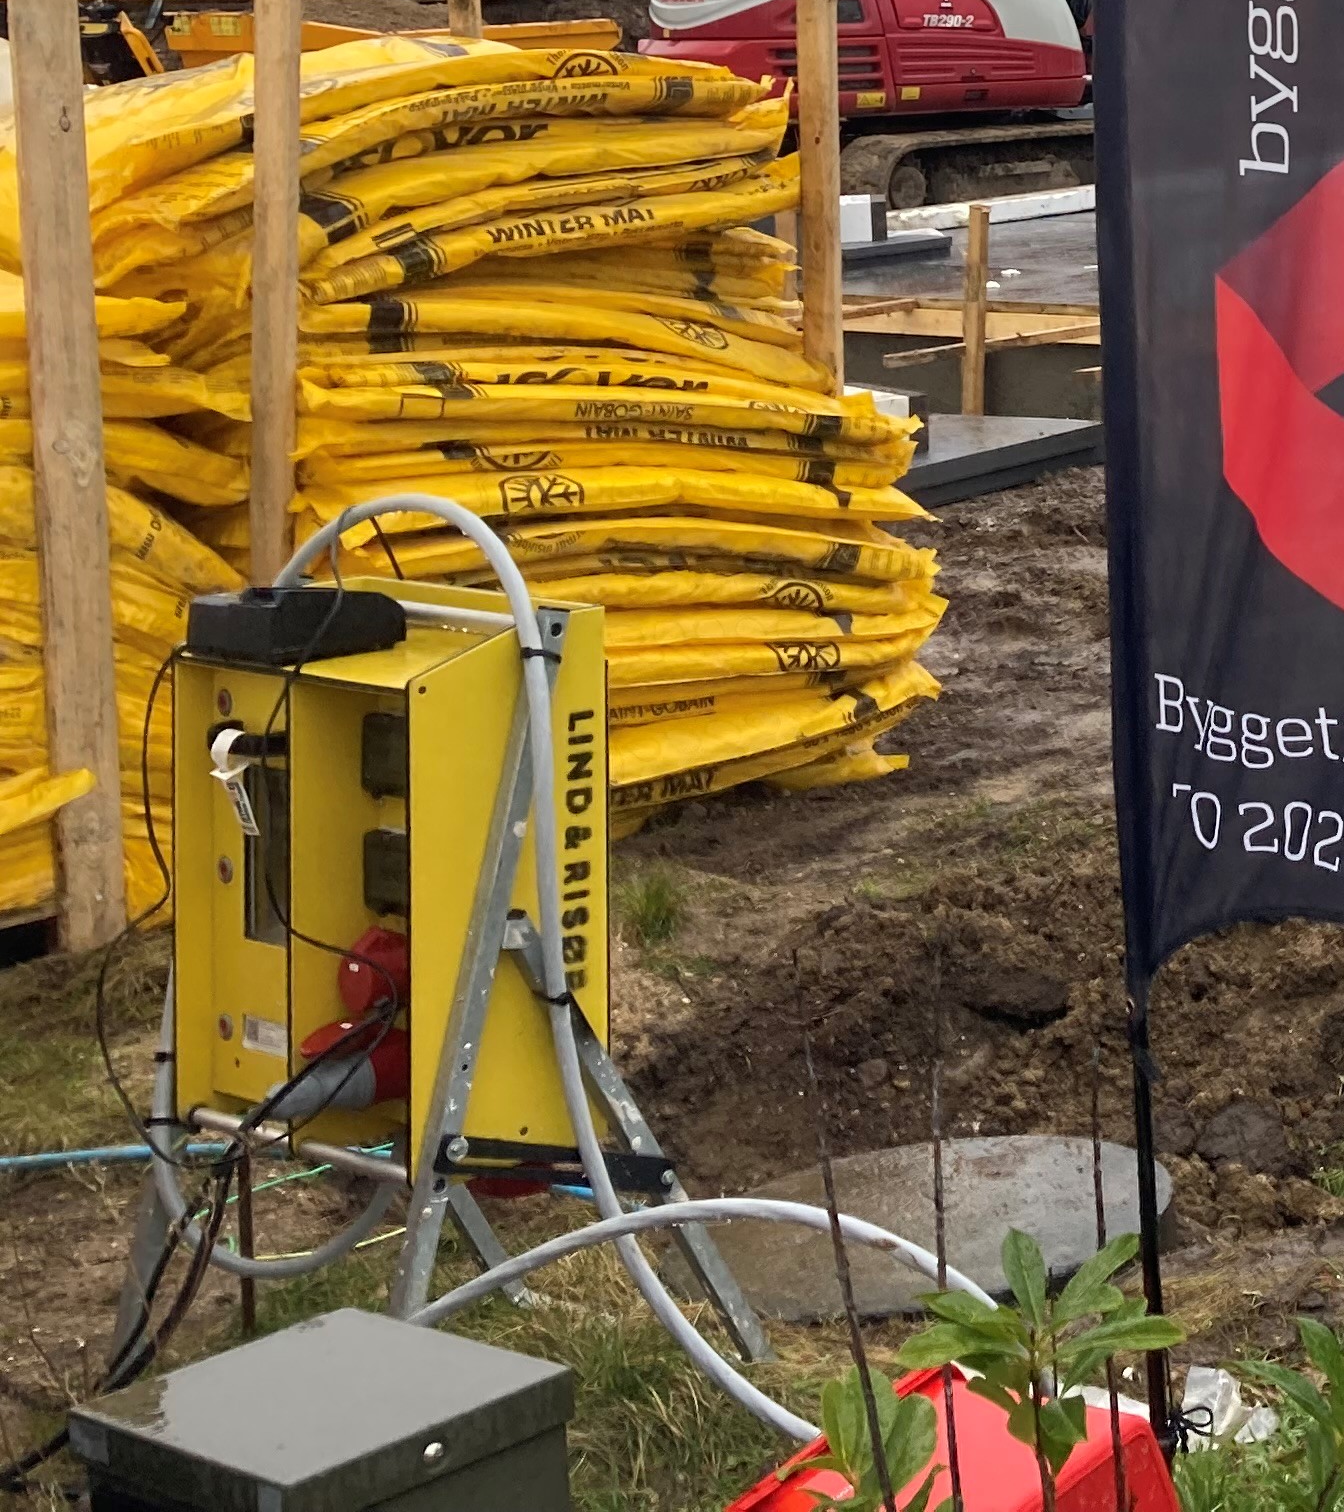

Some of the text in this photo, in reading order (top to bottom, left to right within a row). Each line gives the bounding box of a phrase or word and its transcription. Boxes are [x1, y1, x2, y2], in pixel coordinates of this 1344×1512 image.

[923, 14, 975, 28] TB290-2
[486, 215, 595, 244] WINTER
[575, 401, 694, 420] SAINT-GOBAIN
[607, 695, 715, 720] AINT-GOBAIN
[566, 709, 595, 816] LIND
[1237, 801, 1344, 872] 202
